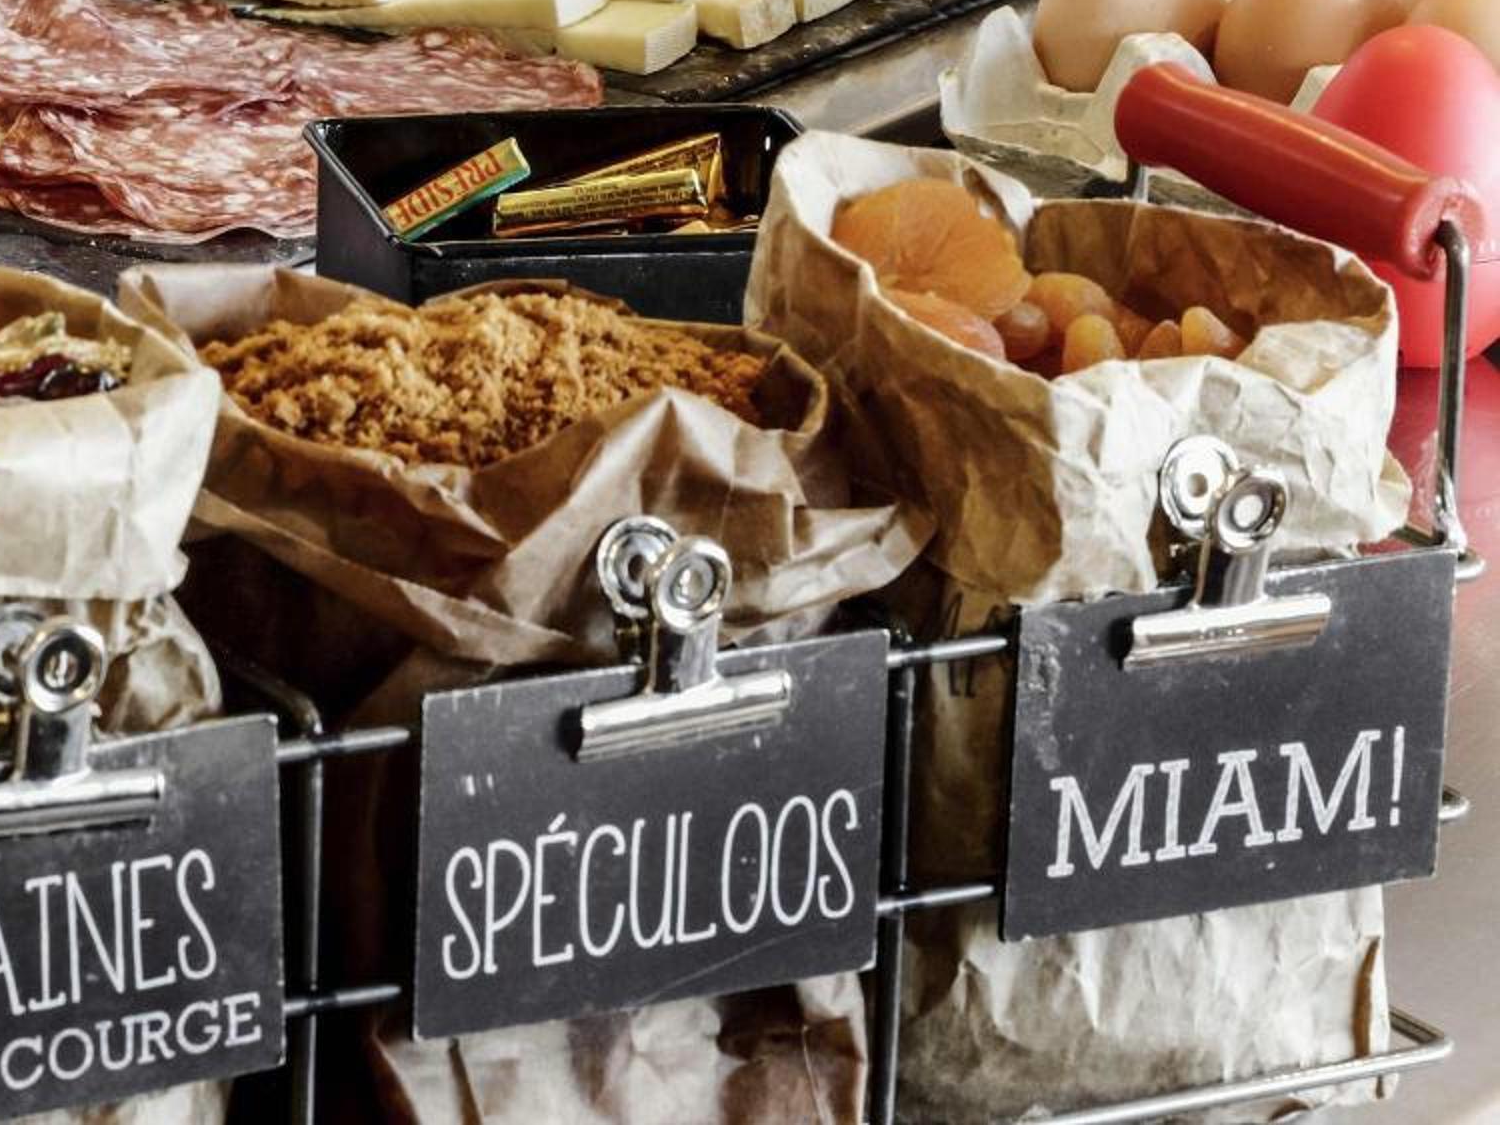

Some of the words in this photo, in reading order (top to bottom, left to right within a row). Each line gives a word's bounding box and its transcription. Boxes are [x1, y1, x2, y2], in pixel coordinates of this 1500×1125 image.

[1046, 724, 1406, 878] MIAM!
[442, 787, 860, 981] SPÉCULOOS
[0, 991, 263, 1092] COURGE
